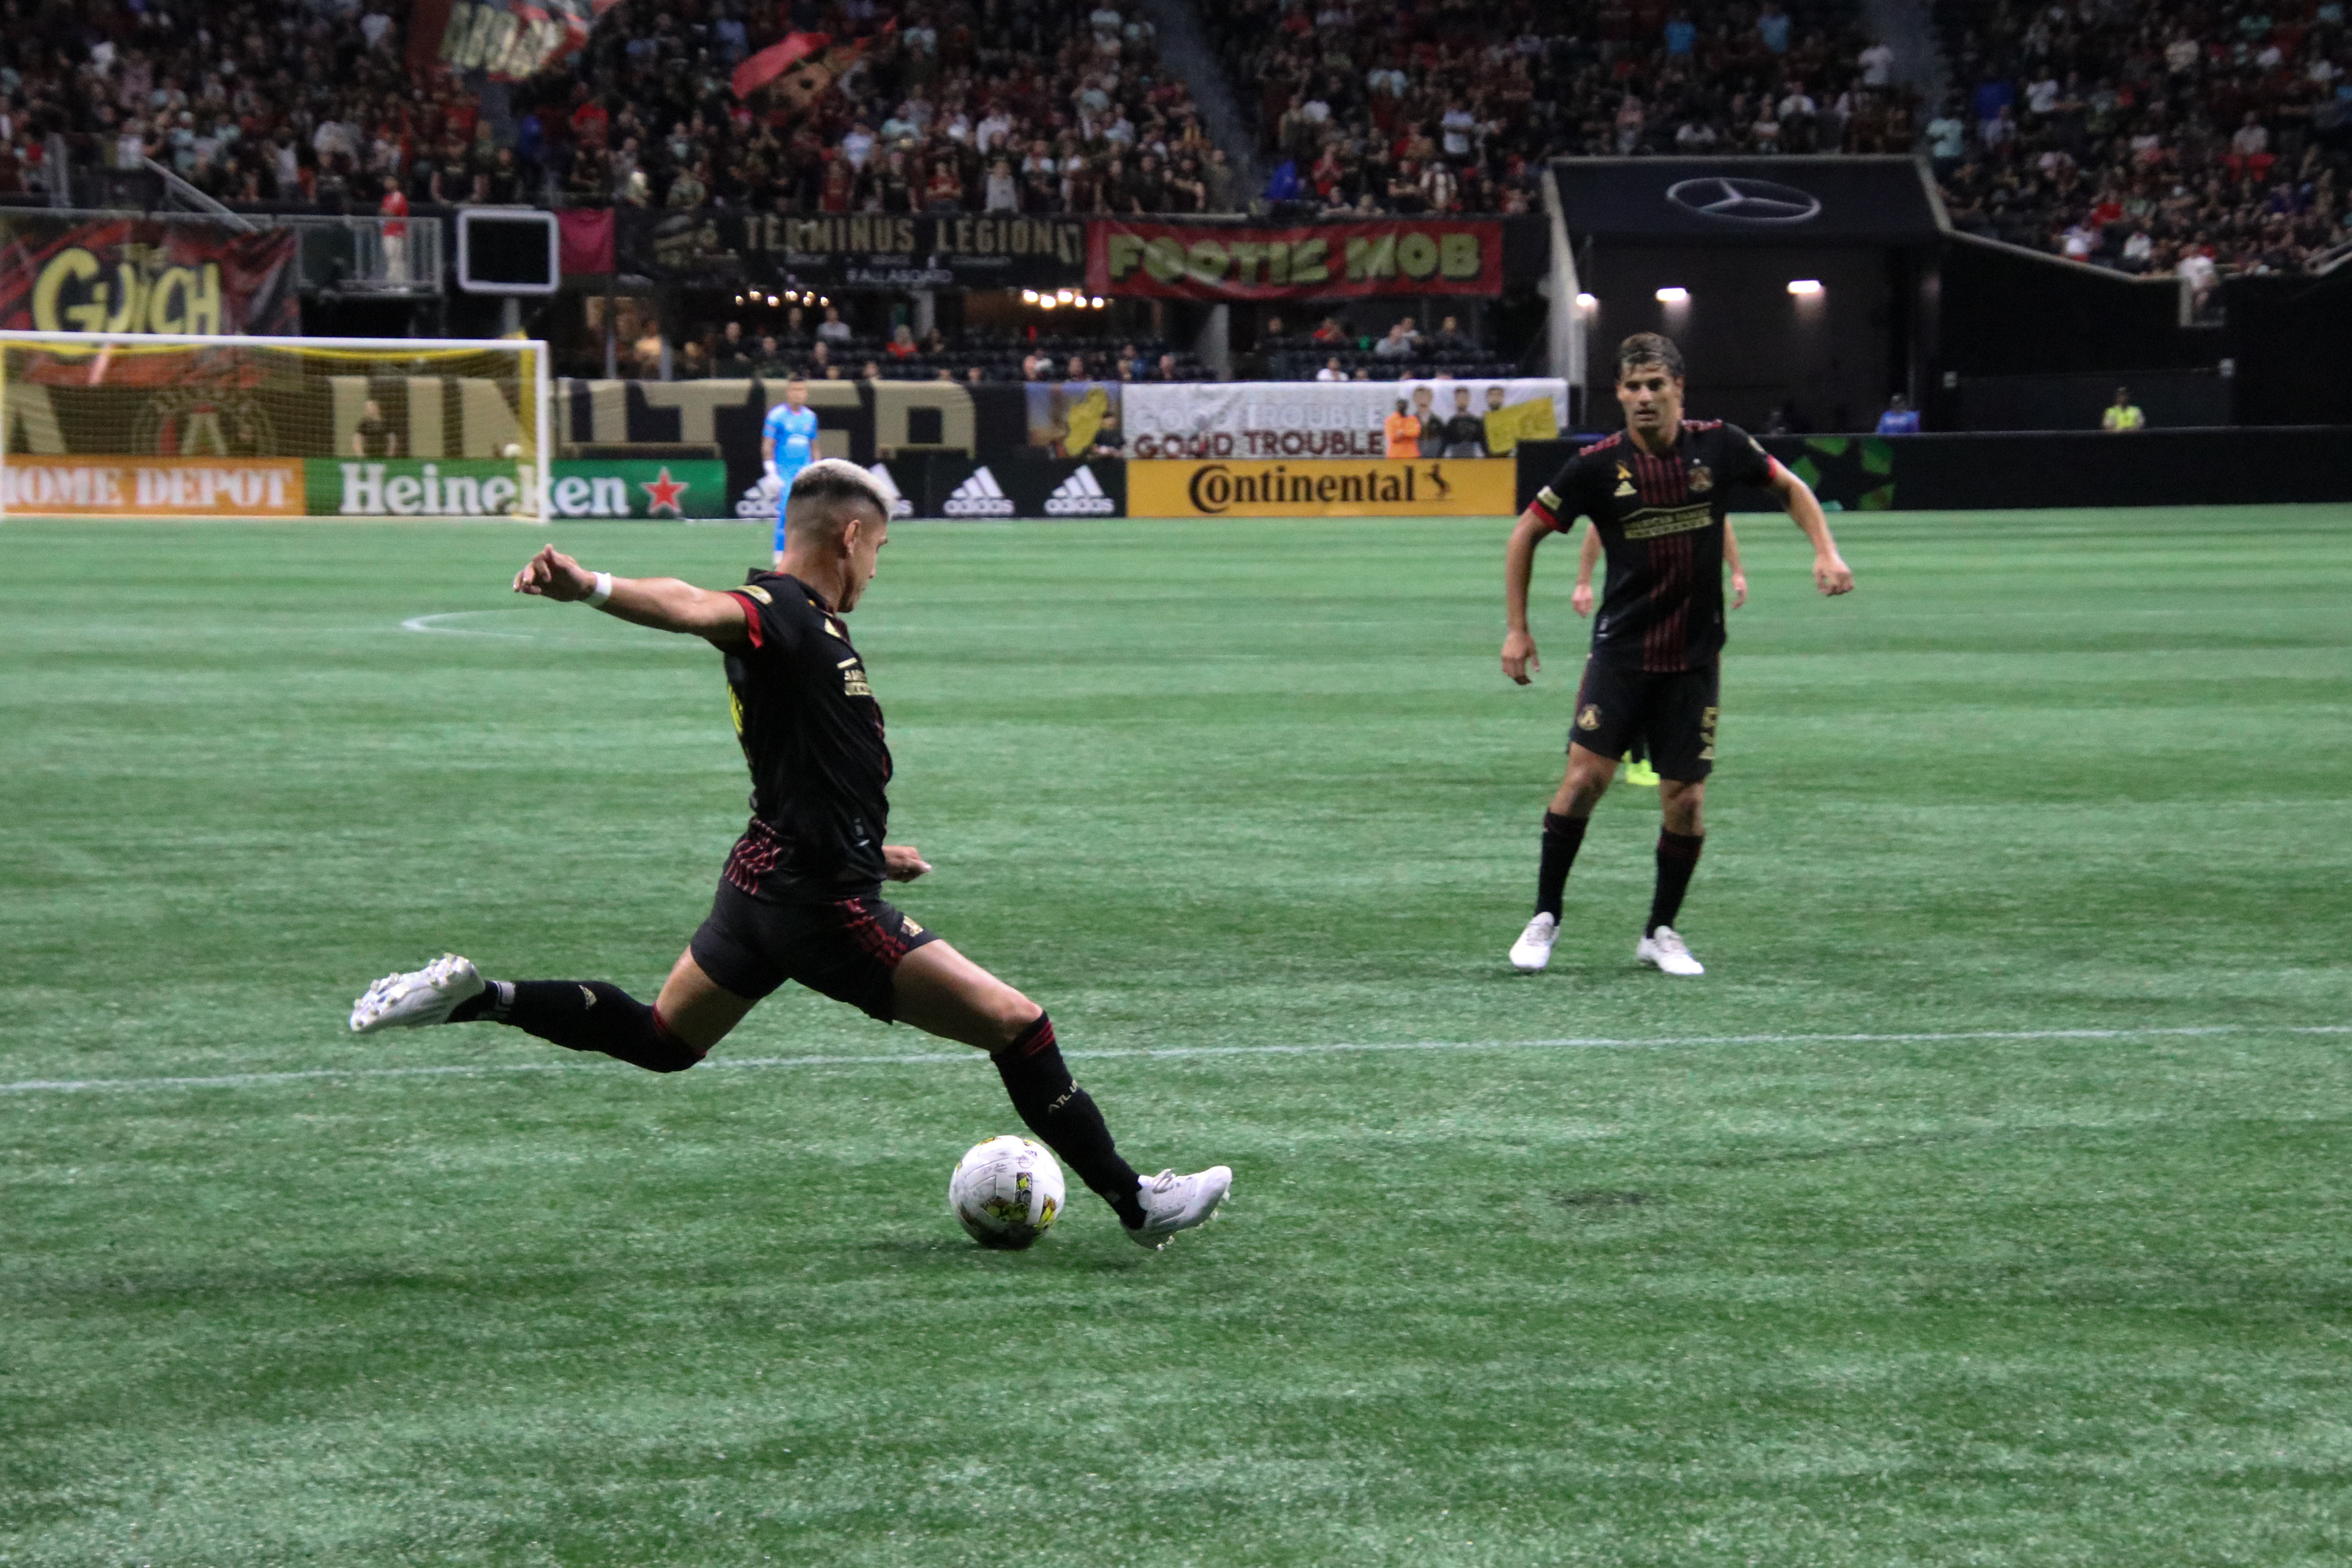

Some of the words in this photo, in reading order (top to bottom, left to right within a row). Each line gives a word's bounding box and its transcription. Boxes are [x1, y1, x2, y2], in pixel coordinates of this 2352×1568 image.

[744, 214, 915, 252] TERMINUS
[936, 216, 1054, 253] LEGION
[1108, 233, 1330, 286] FOOTIE
[1346, 232, 1480, 281] MOB
[1134, 432, 1234, 459] GOOD
[1243, 430, 1384, 456] TROUBLE
[136, 467, 293, 508] DEPOT
[339, 462, 630, 516] Heineken
[943, 497, 1015, 516] adidas
[1044, 496, 1115, 515] adidas
[1189, 464, 1415, 514] Continental
